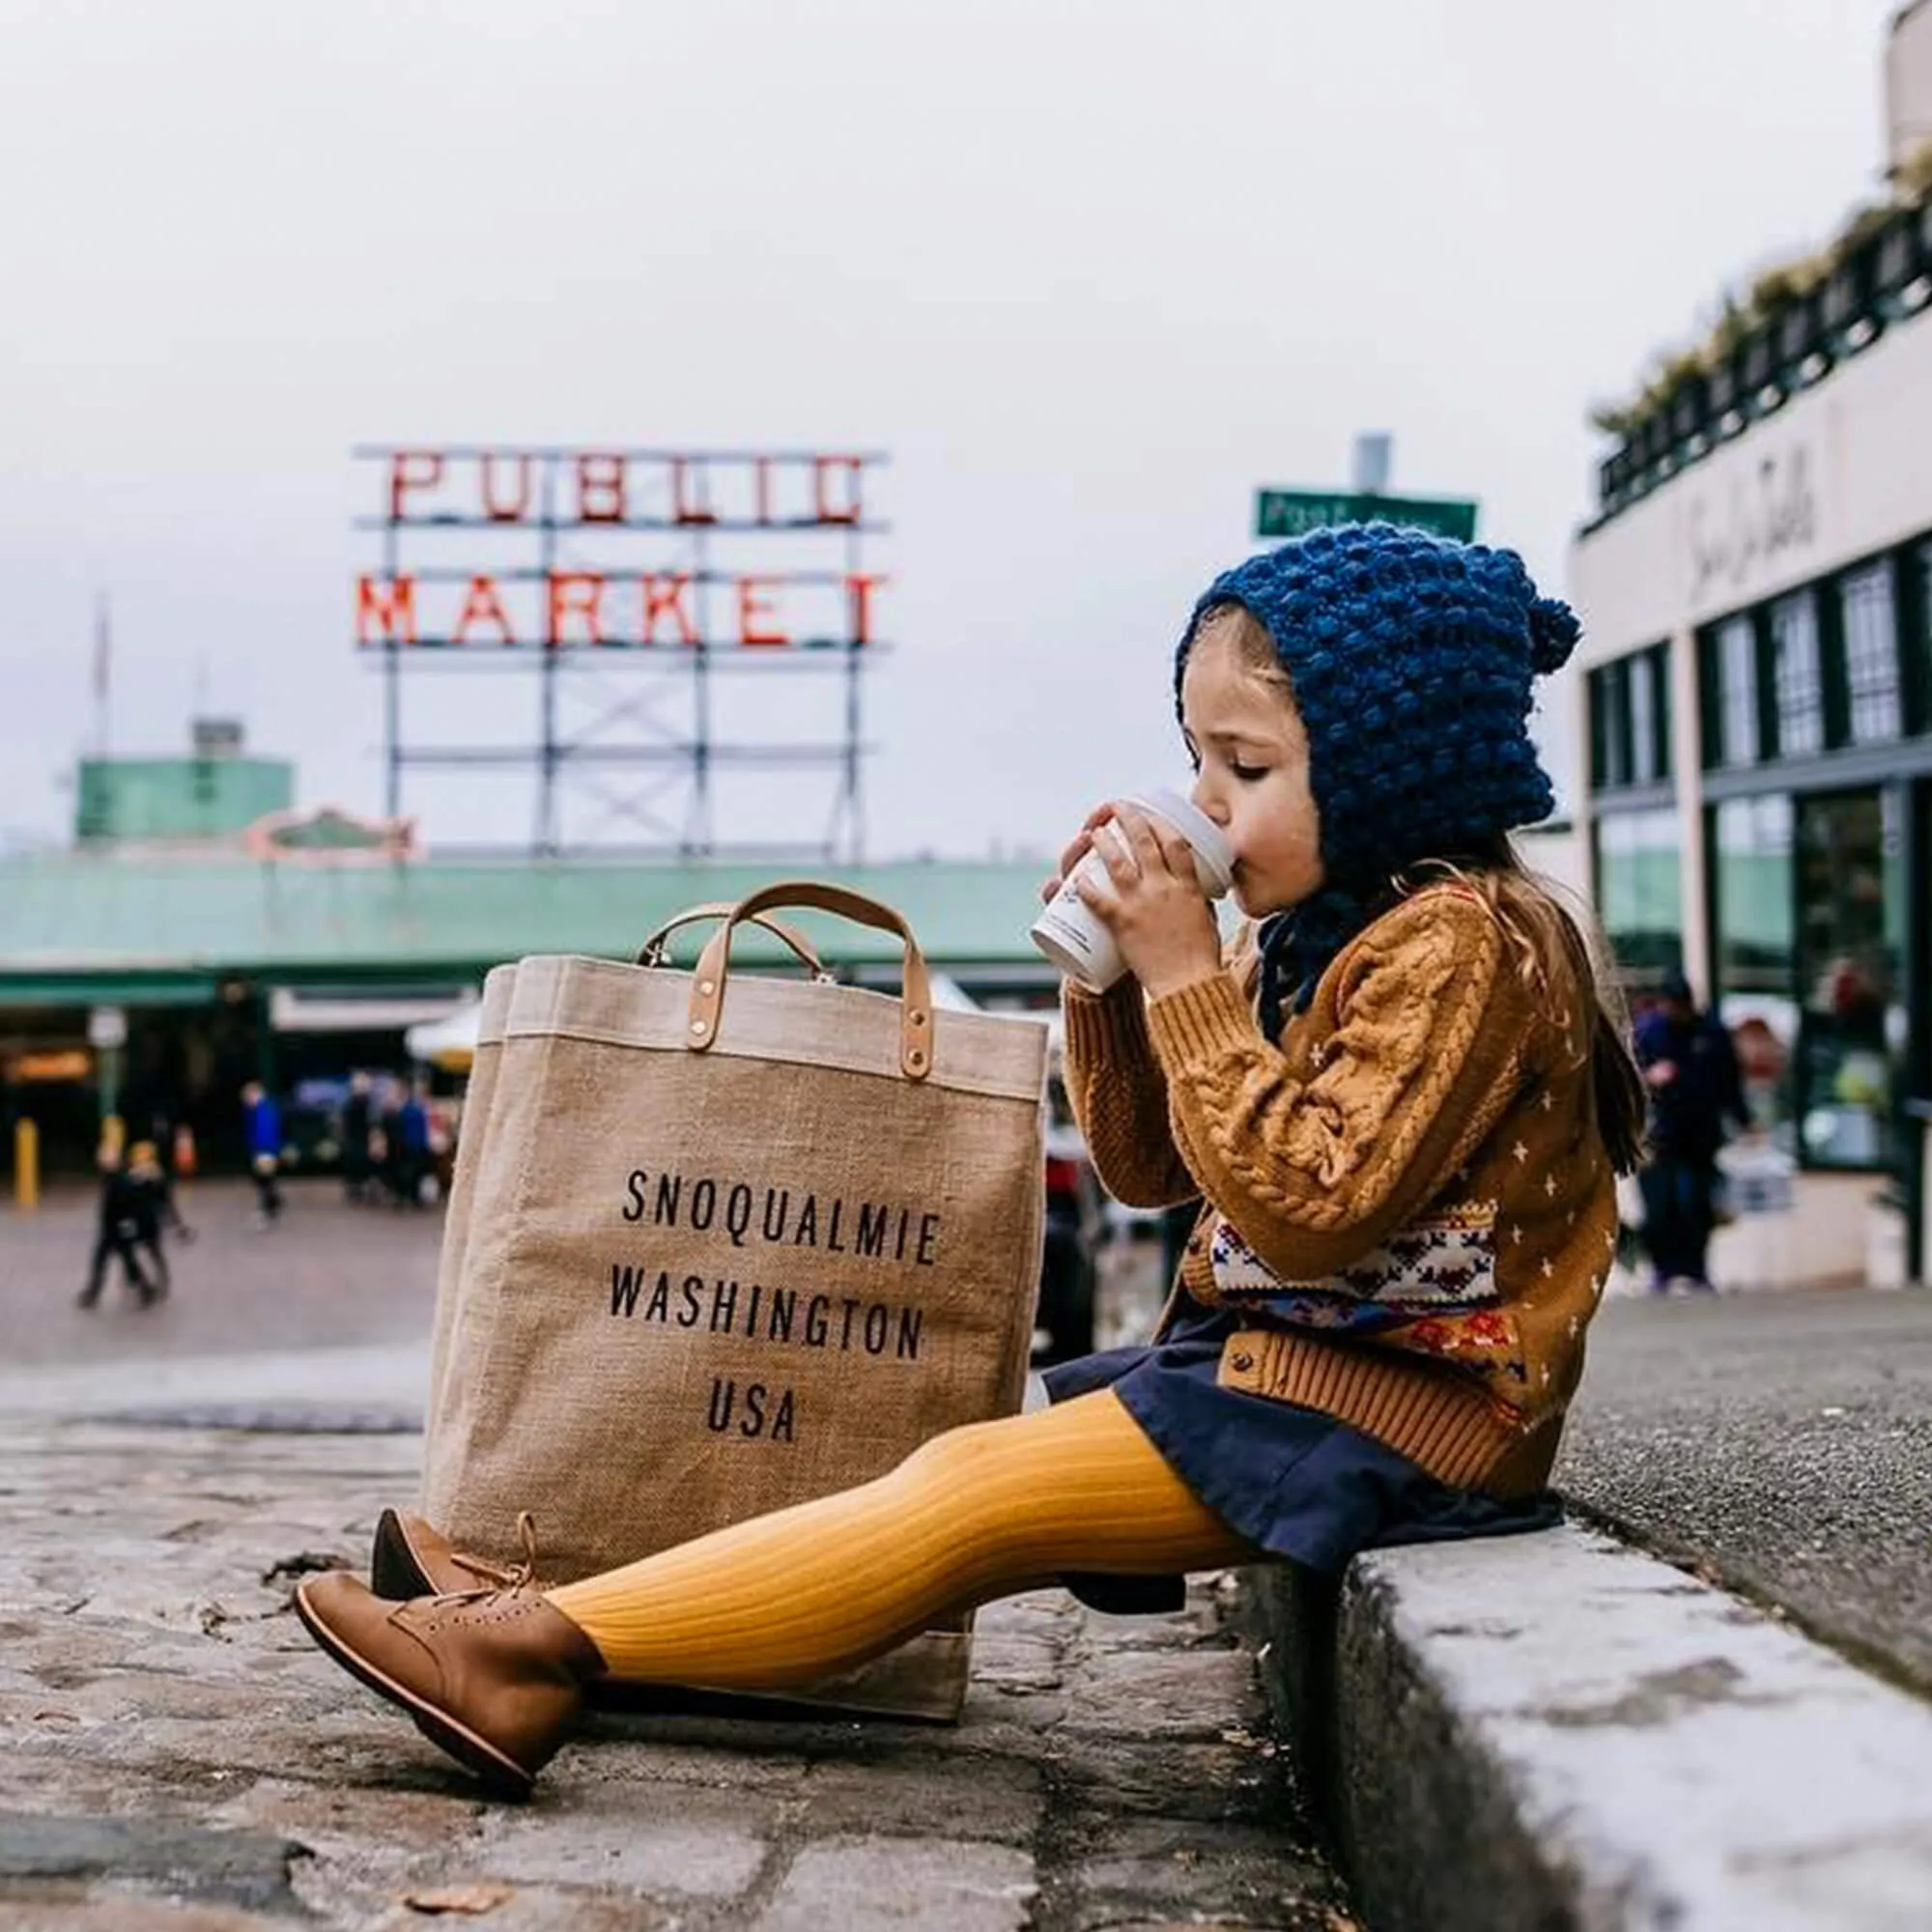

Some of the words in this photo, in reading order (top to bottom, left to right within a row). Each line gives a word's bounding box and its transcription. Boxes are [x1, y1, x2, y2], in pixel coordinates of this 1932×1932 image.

[389, 451, 861, 524] PUBLIC
[355, 570, 886, 646] MARKET
[623, 1170, 941, 1265] SNOQUALMIE
[611, 1264, 923, 1359] WASHINGTON
[708, 1378, 796, 1442] USA
